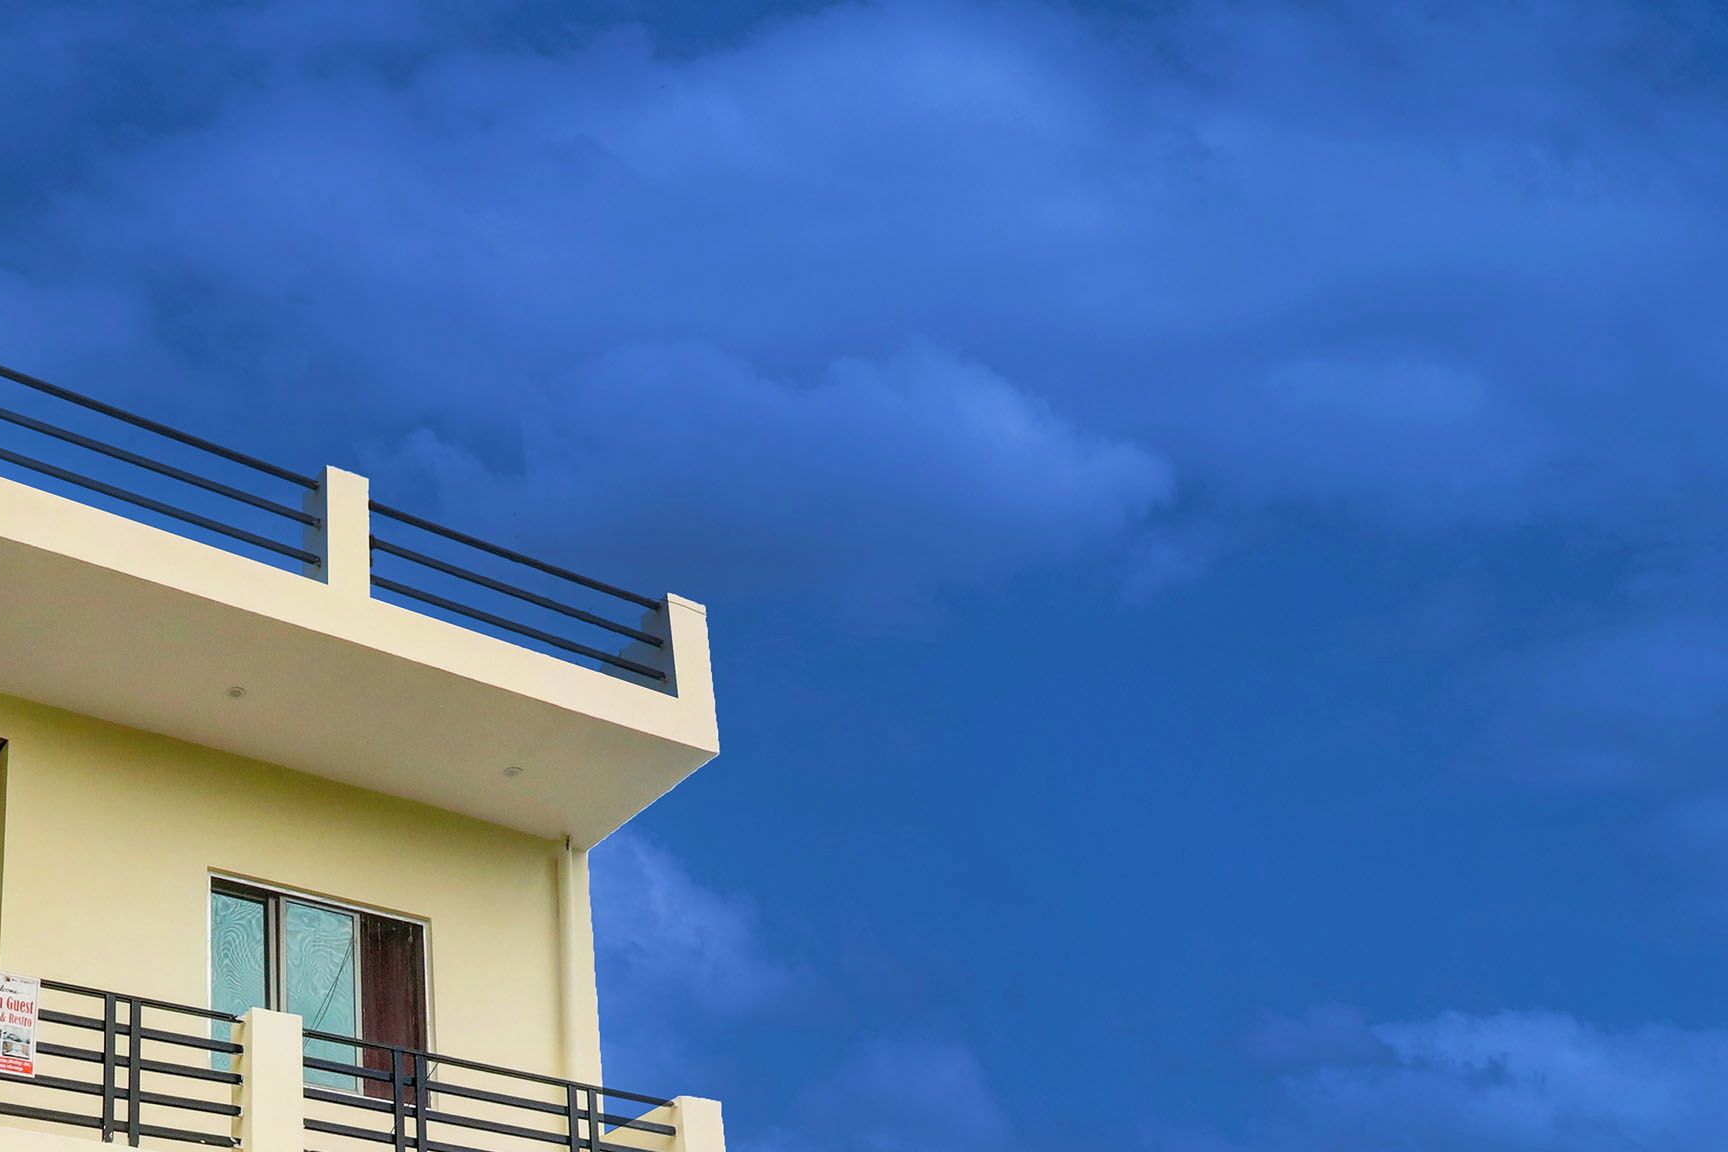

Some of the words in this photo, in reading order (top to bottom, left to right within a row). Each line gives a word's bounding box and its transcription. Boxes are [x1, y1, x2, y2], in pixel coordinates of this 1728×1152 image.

[6, 996, 34, 1014] Guest
[0, 1012, 6, 1023] &
[8, 1013, 33, 1028] Restro
